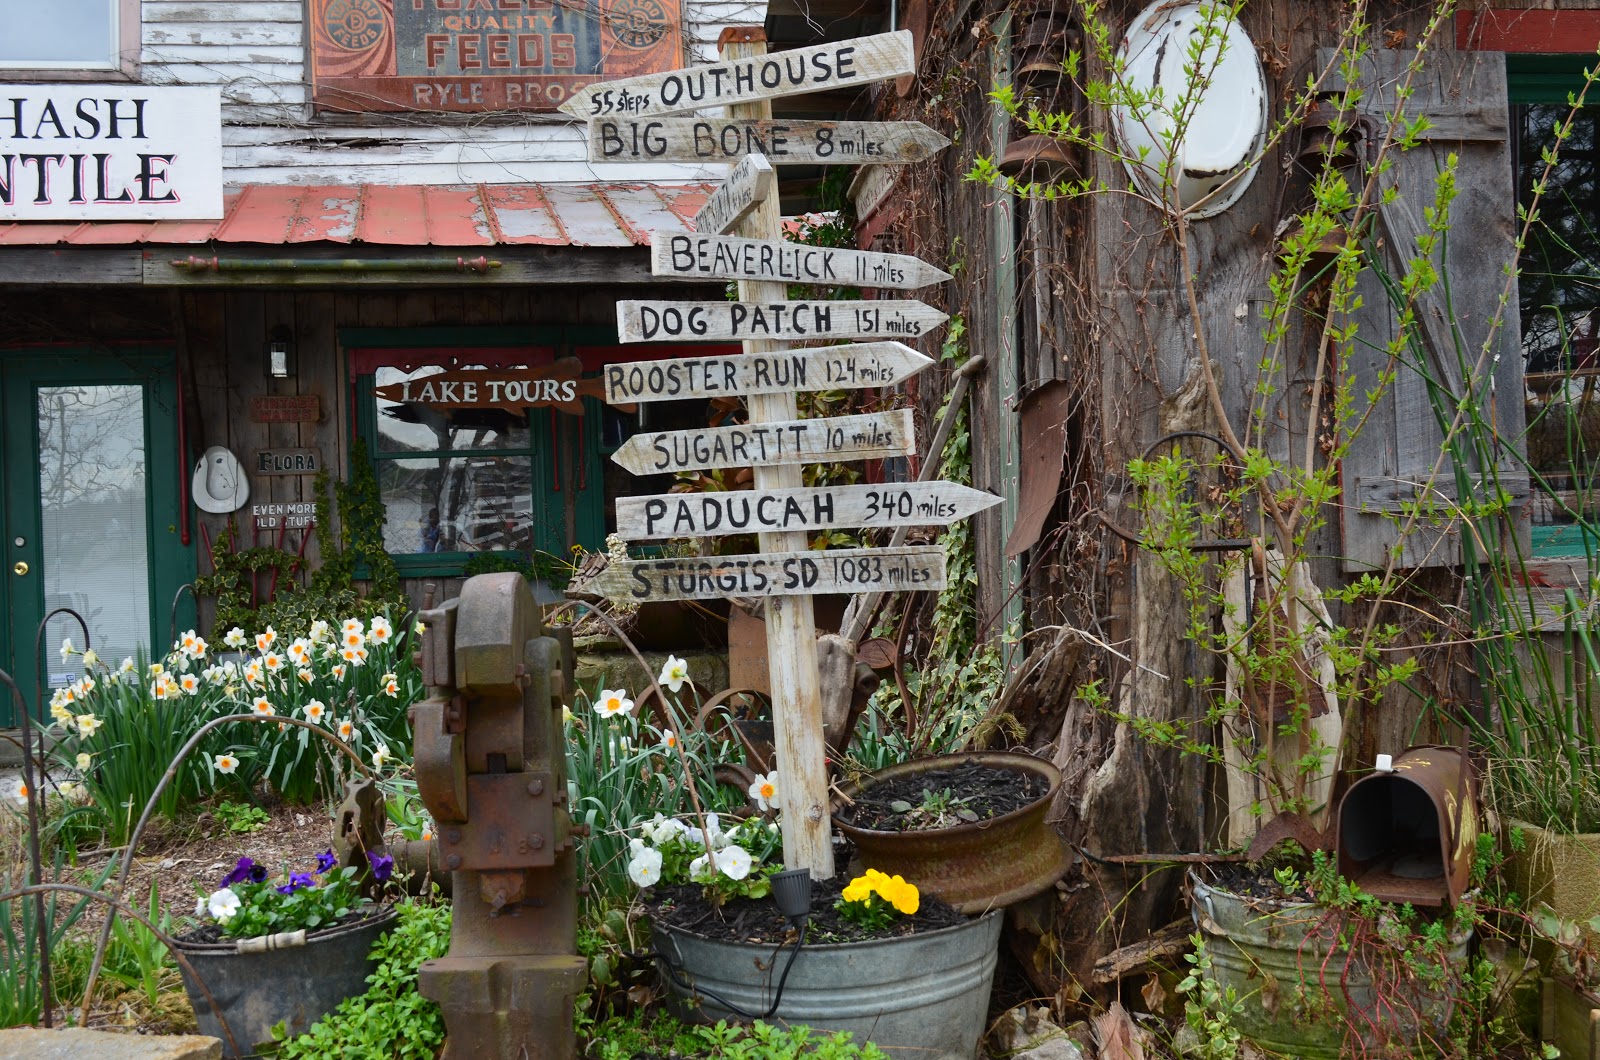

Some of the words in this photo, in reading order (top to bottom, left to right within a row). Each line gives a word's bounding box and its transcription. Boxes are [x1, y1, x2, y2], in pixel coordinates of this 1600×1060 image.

[333, 28, 378, 47] FEEDS
[444, 15, 557, 31] QUALITY
[425, 34, 576, 69] FEEDS
[413, 83, 484, 105] RYLE
[591, 90, 614, 115] 55
[660, 46, 857, 106] OUTHOUSE
[0, 98, 149, 139] HASH
[602, 122, 667, 157] BIG
[693, 122, 790, 157] BONE
[815, 127, 834, 157] 8
[671, 235, 836, 280] BEAVERLICK
[856, 255, 867, 281] 11
[641, 306, 707, 339] DOG
[731, 304, 832, 336] PATCH
[855, 308, 879, 333] 151
[401, 381, 478, 403] LAKE
[485, 380, 577, 402] TOURS
[609, 360, 738, 400] ROOSTER
[755, 356, 807, 388] RUN
[826, 357, 856, 384] 124
[826, 428, 844, 450] 10
[257, 452, 315, 471] FLORA
[252, 505, 284, 516] EVEN
[287, 503, 317, 514] MORE
[283, 515, 318, 527] TUFF
[645, 492, 835, 535] PADUCAH
[864, 491, 912, 521] 340
[783, 557, 819, 589] SD
